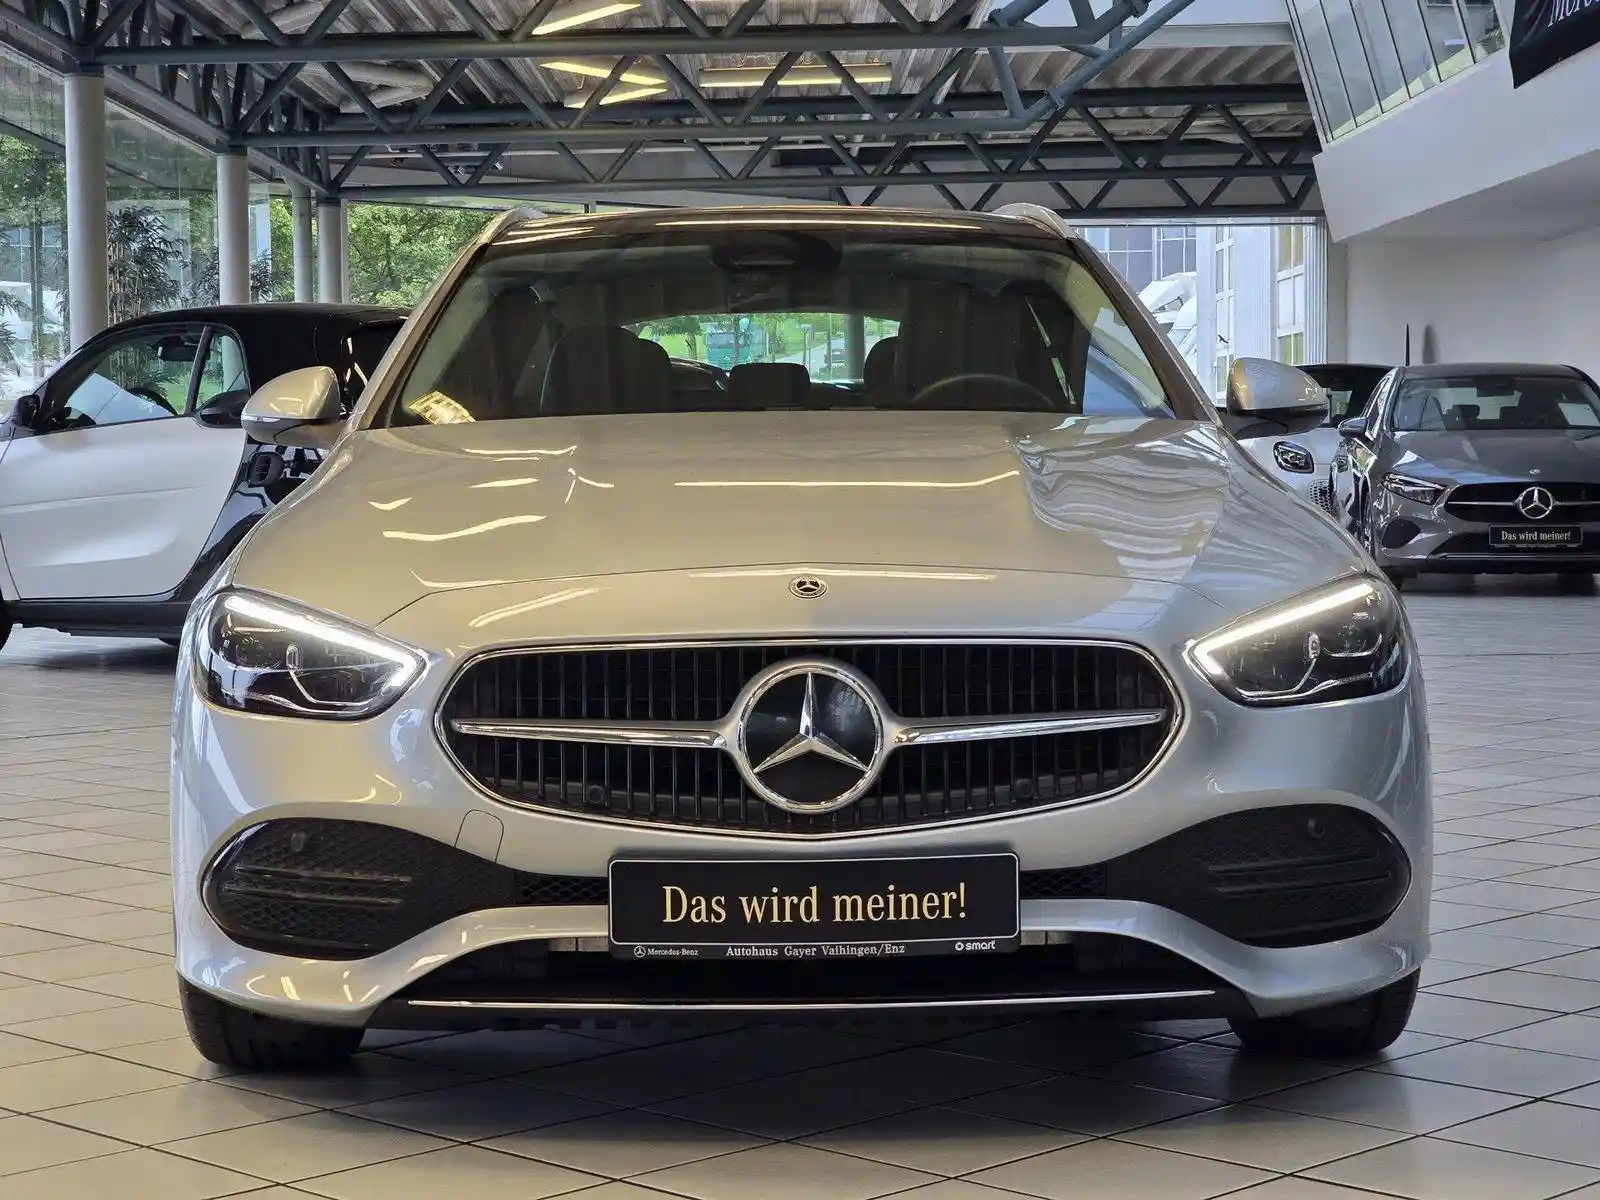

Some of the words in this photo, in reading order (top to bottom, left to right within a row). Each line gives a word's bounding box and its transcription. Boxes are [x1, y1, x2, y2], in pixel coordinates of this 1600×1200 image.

[1501, 530, 1517, 541] Das
[1519, 530, 1538, 541] wird
[1540, 530, 1571, 541] meiner!
[662, 885, 726, 923] Das
[739, 885, 820, 923] wird
[833, 882, 966, 922] meiner!
[726, 945, 778, 957] Autohaus
[784, 945, 817, 958] Gayer
[821, 944, 906, 957] Vaihingen/Enz
[965, 940, 996, 951] smart
[647, 947, 699, 956] Mercedes-Benz
